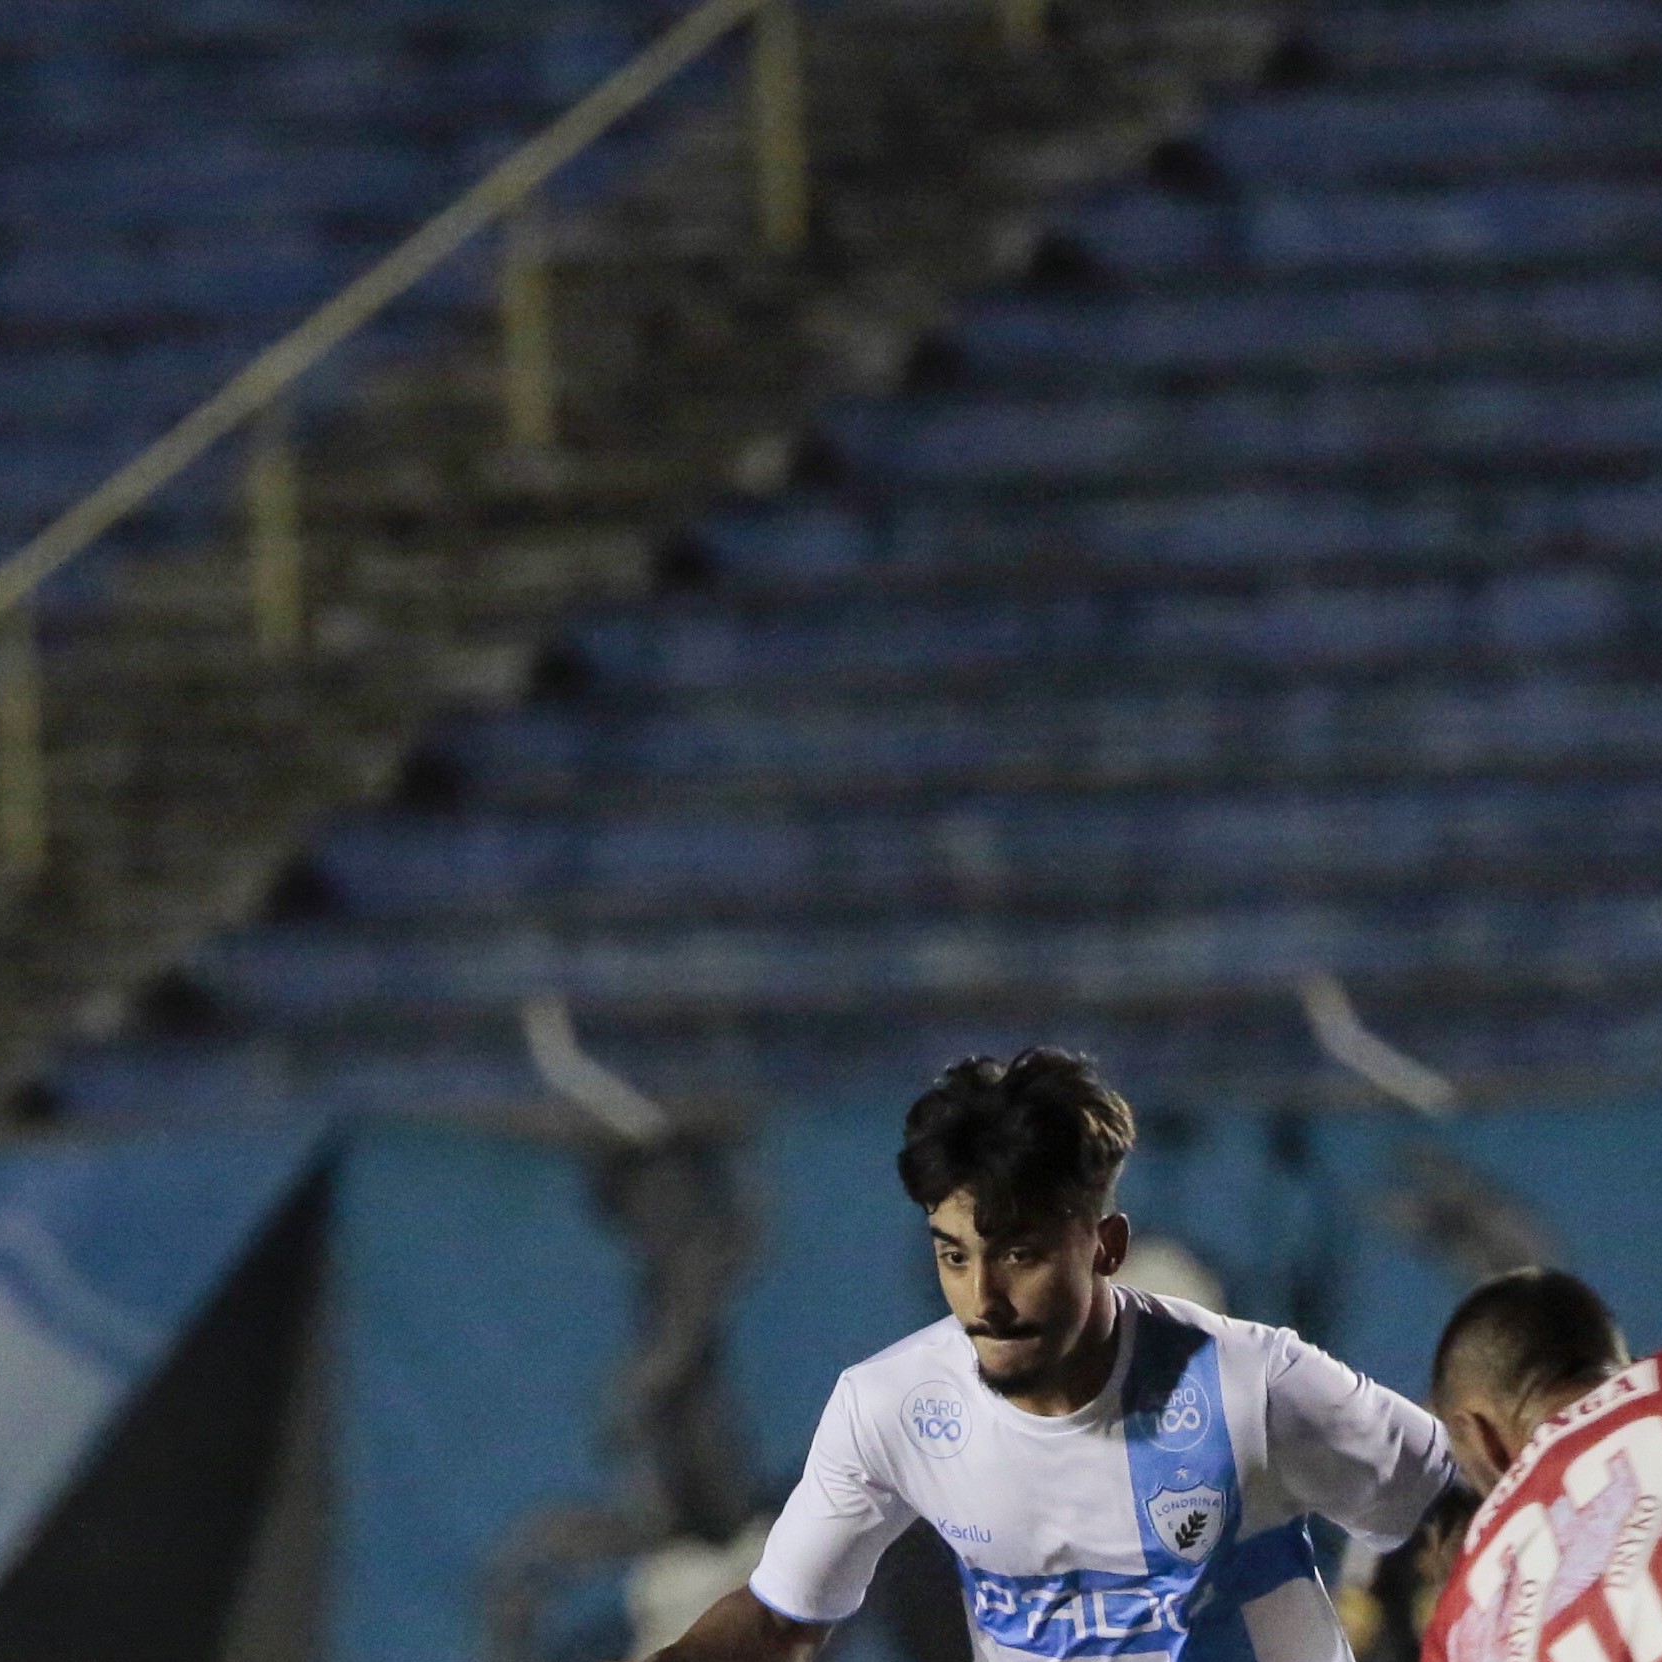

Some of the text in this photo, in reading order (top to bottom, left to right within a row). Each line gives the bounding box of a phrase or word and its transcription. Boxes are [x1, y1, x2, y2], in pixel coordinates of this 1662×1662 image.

[912, 1397, 962, 1418] AGRO
[913, 1416, 962, 1443] 100
[1154, 1495, 1221, 1517] LONDRINA
